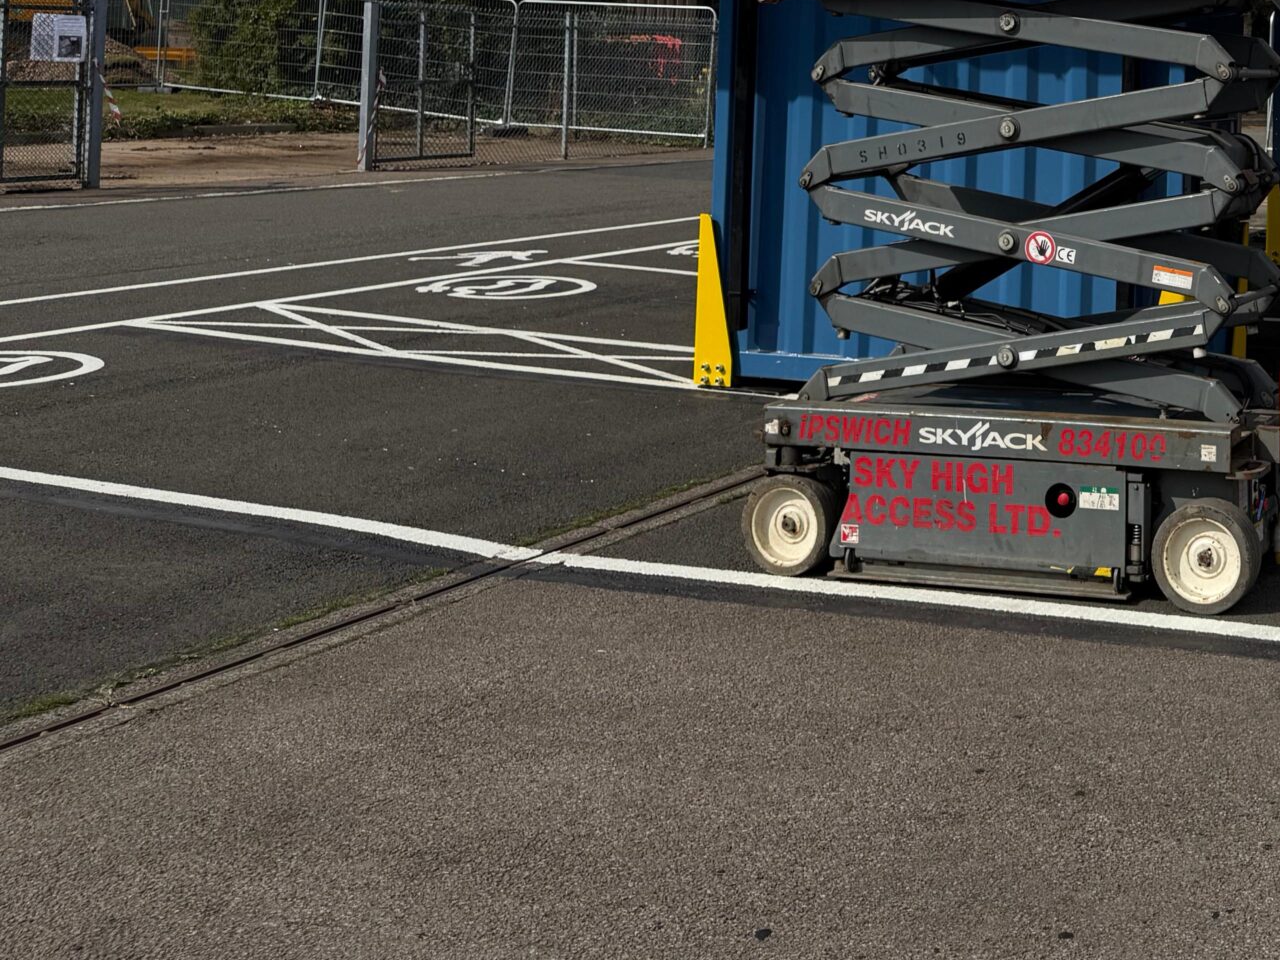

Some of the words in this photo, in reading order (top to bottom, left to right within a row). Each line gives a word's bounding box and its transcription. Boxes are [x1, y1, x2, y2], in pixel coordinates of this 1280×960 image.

[863, 209, 955, 238] SKYJACK
[918, 421, 1048, 451] SKYJACK
[1057, 428, 1167, 462] 834100
[853, 455, 921, 490] SKY
[930, 460, 1015, 496] HIGH
[841, 492, 977, 533] ACCESS
[987, 502, 1062, 538] LTD.
